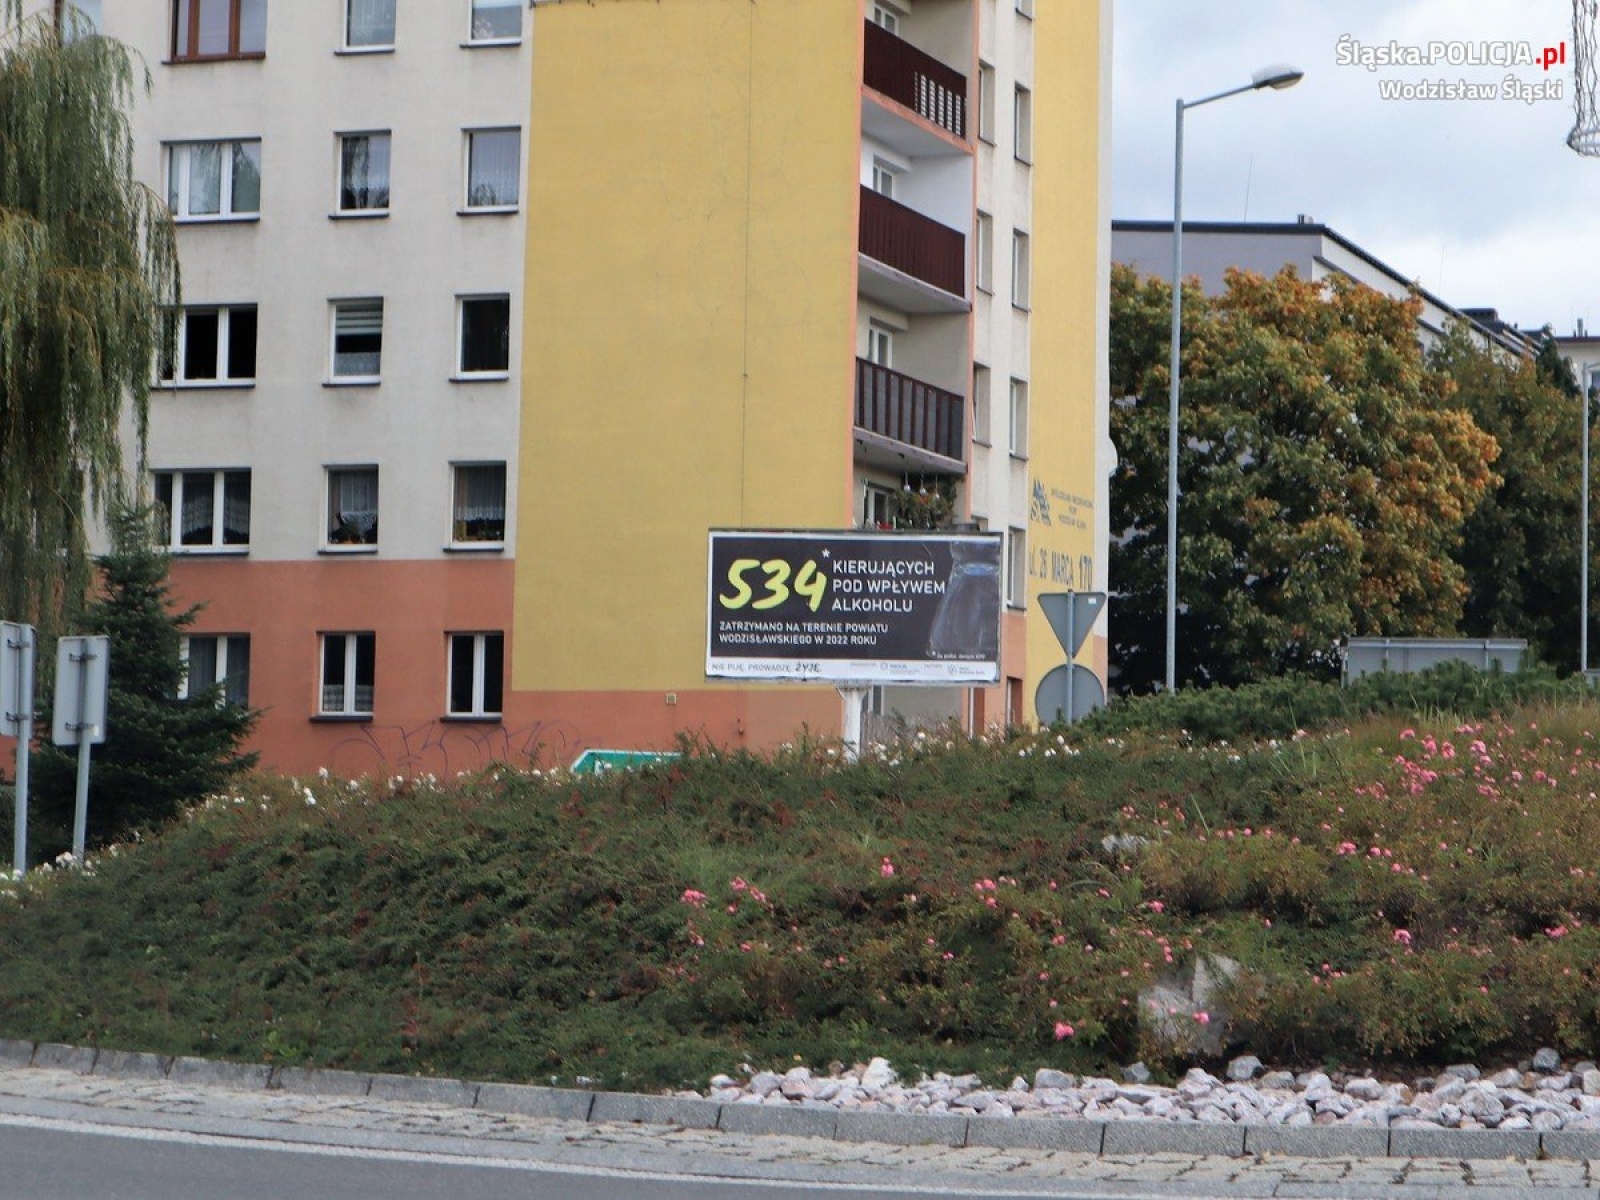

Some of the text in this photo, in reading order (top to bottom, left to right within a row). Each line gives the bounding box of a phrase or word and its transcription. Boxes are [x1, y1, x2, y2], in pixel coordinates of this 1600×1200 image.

[832, 559, 935, 578] KIERUJĄCYCH
[1051, 550, 1074, 587] MARCA
[832, 578, 946, 595] POD WPŁYWEM
[831, 597, 913, 613] ALKOHOLU
[719, 620, 889, 634] ZATRZYMANO NA TERENIE POWIATU
[719, 633, 877, 646] WODZISŁAWSKIEGO W 2022 ROKU
